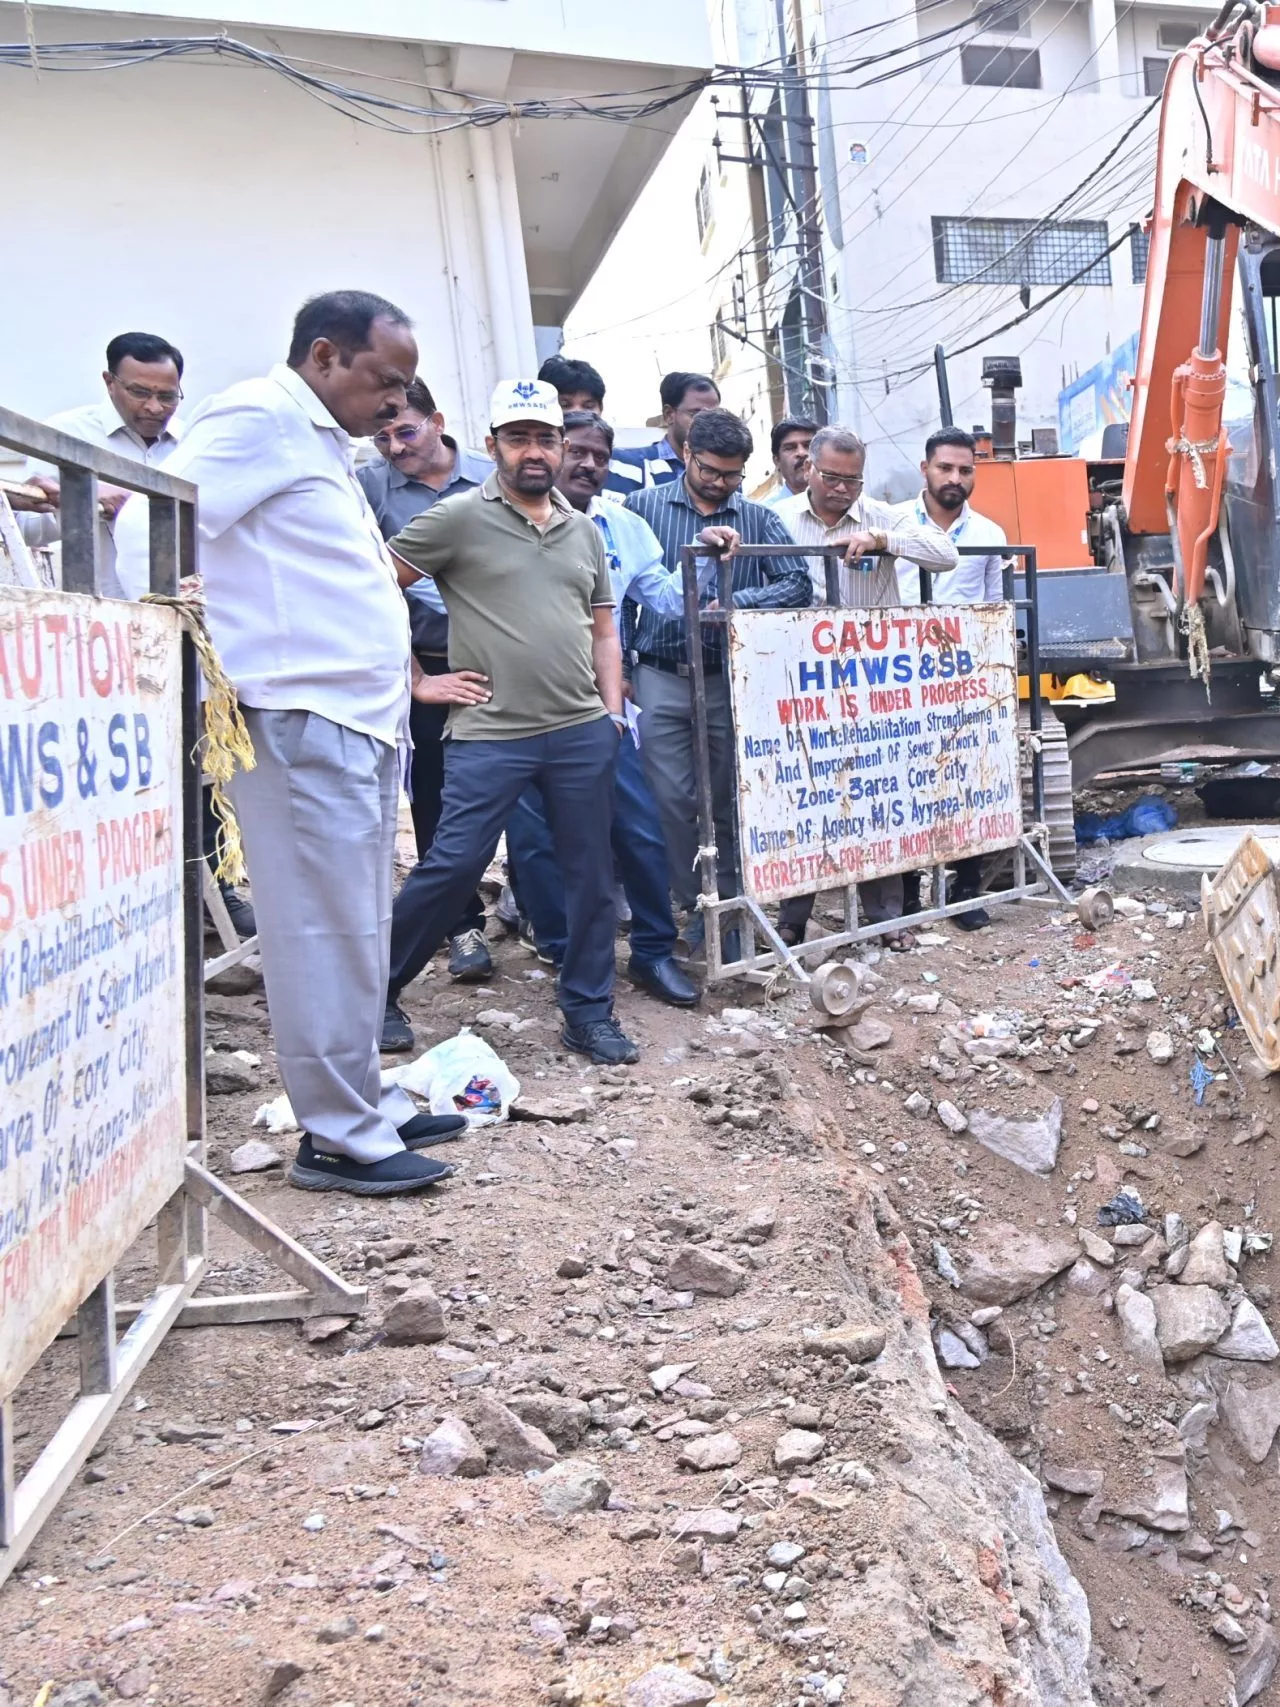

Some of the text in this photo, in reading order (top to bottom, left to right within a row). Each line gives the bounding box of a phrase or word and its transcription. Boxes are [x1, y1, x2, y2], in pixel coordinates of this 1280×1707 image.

[813, 616, 961, 654] CAUTION
[777, 678, 988, 724] WORK IS UNDER PROGRESS
[76, 717, 98, 800] &
[108, 713, 152, 792] SB
[744, 735, 781, 759] Name
[775, 758, 802, 784] And
[809, 746, 882, 780] Improvement
[887, 741, 900, 763] Of
[908, 740, 935, 760] Sewer
[940, 729, 979, 754] Network
[908, 766, 937, 789] Core
[944, 758, 968, 782] city
[749, 826, 788, 855] Name
[796, 818, 812, 844] Of
[822, 815, 865, 843] Agency
[20, 829, 86, 920] UNDER
[840, 844, 865, 873] FOR
[867, 838, 894, 866] THE
